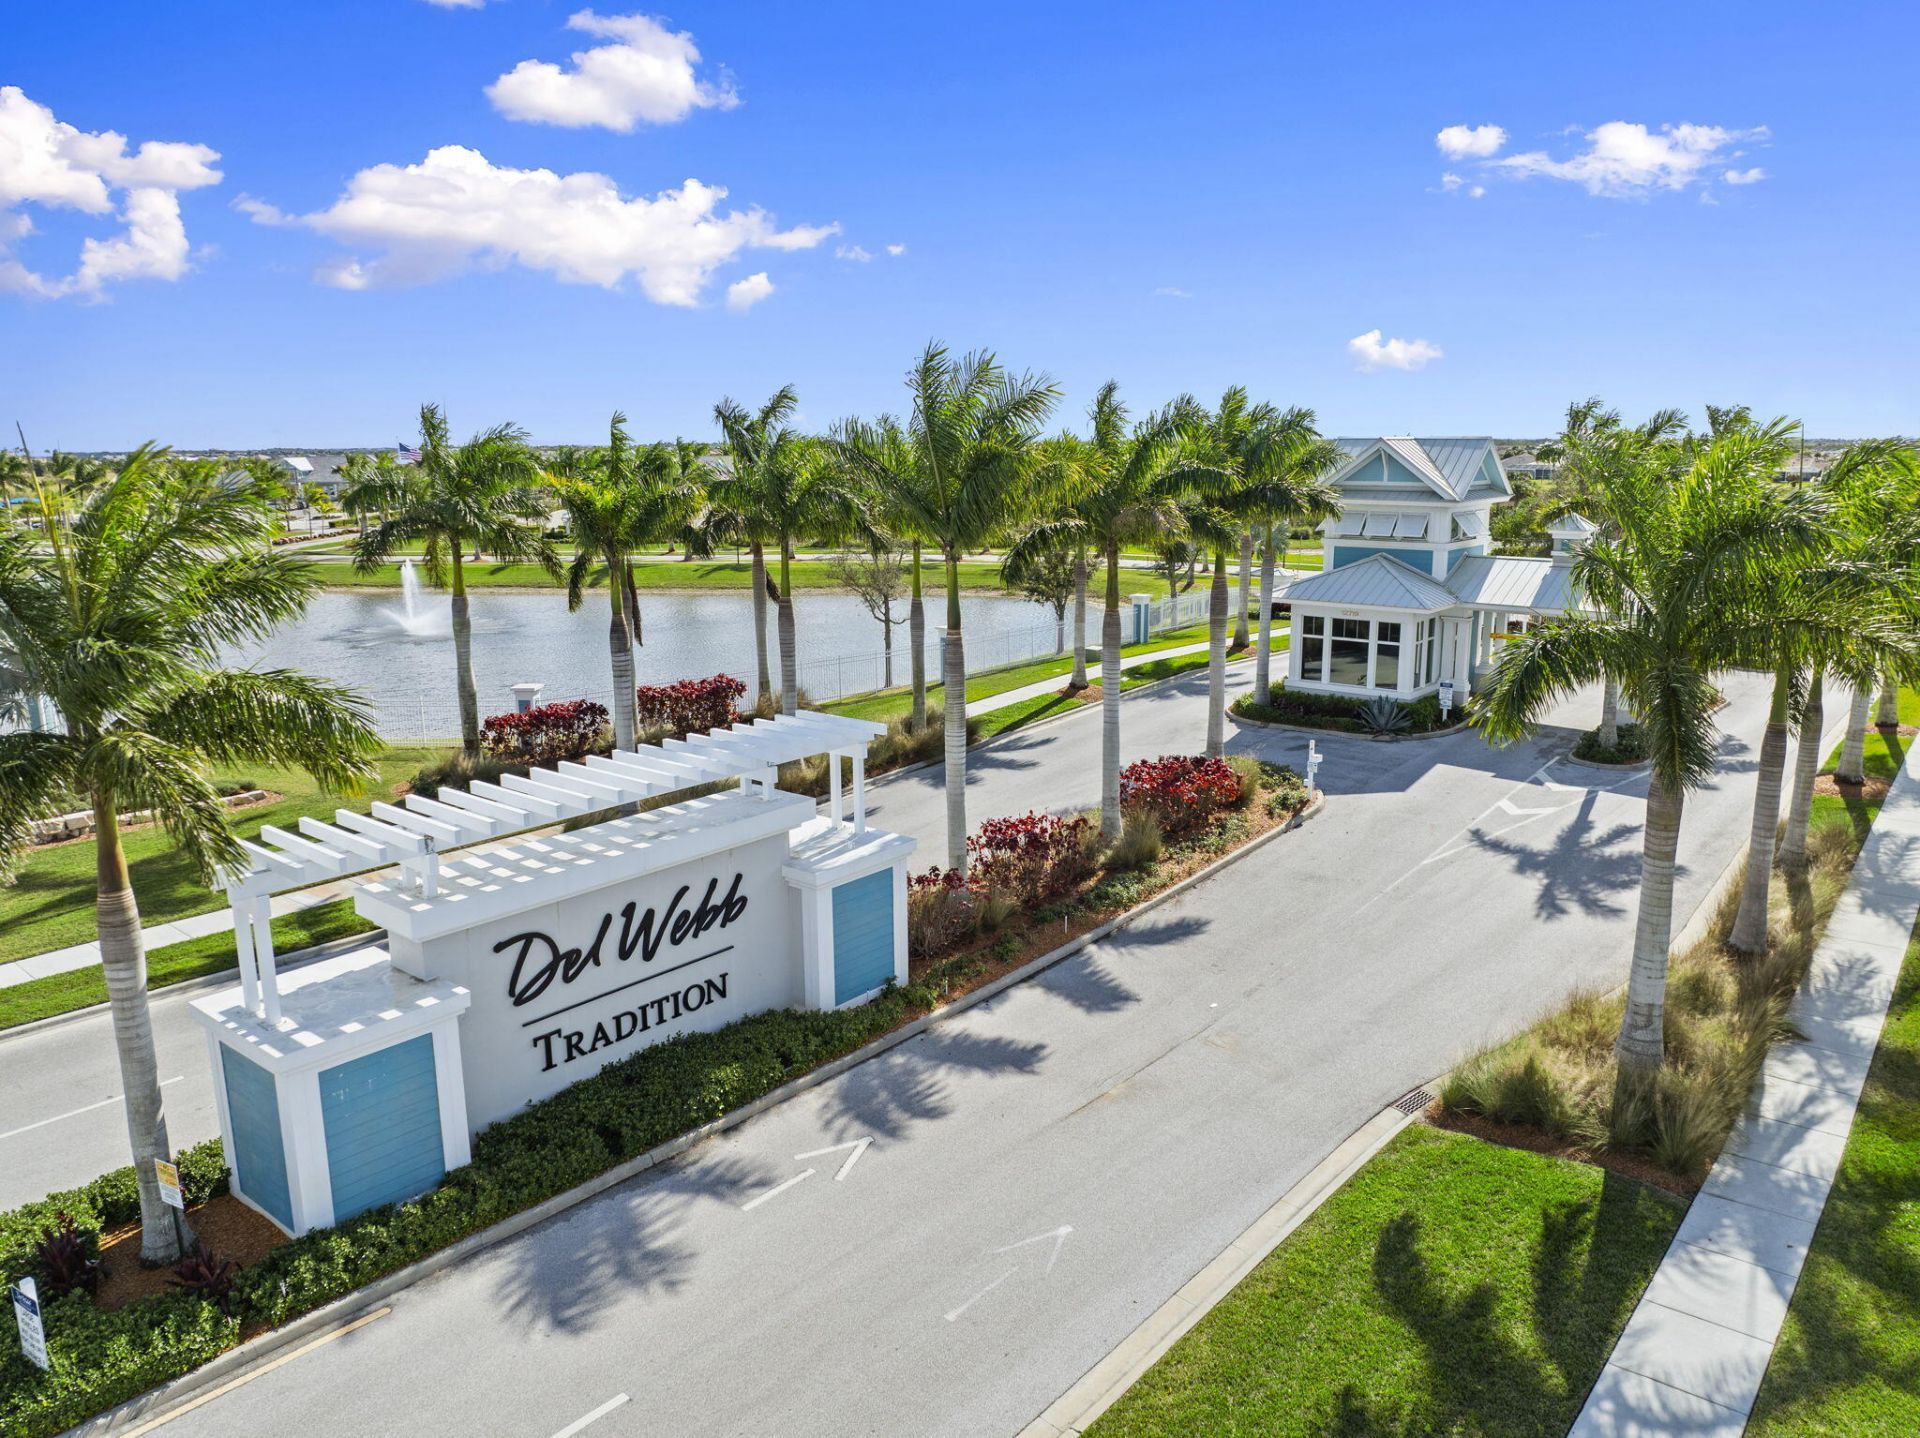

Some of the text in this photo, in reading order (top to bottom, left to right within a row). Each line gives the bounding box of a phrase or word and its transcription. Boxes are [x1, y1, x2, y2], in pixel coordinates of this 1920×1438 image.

[493, 873, 748, 1006] Del Webb
[533, 972, 728, 1072] TRADITION
